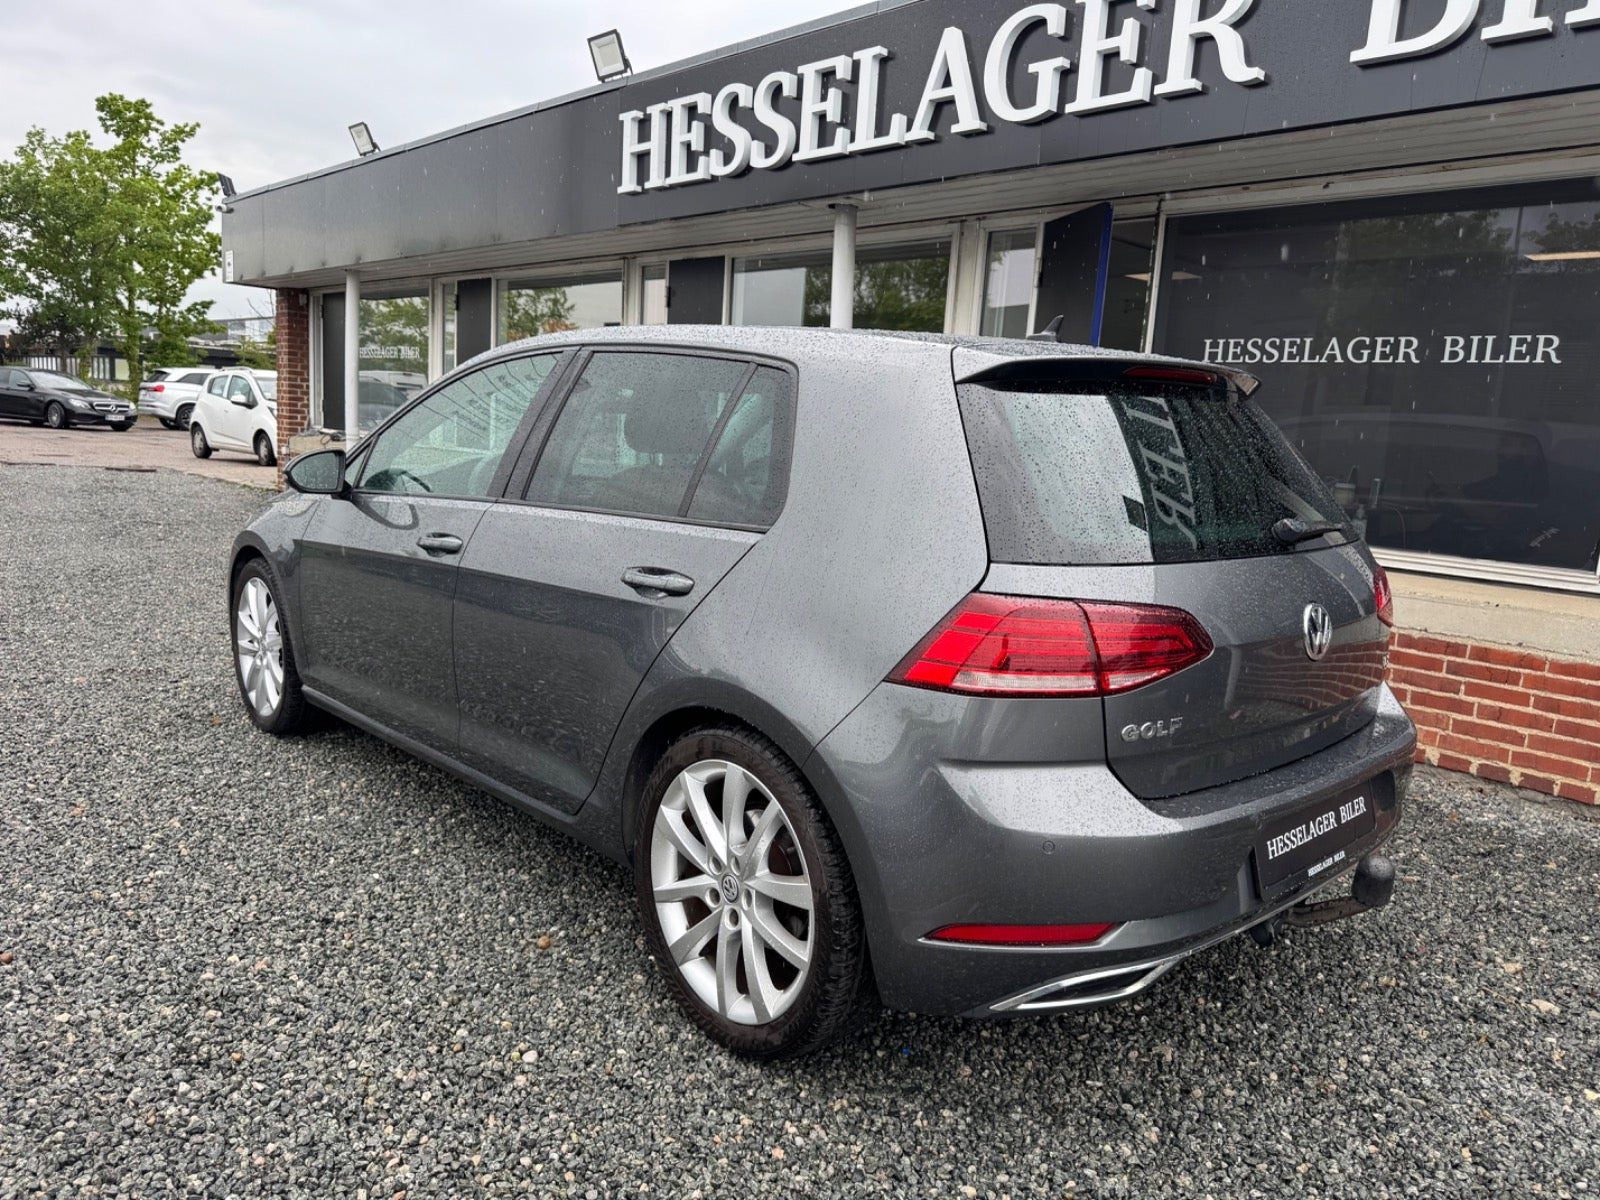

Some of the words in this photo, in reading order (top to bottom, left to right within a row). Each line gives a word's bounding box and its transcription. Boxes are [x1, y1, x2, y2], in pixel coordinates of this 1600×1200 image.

[618, 0, 1266, 193] HESSELAGER
[1204, 337, 1420, 363] HESSELAGER
[1441, 336, 1562, 363] BILER
[1121, 717, 1183, 743] GOLF
[1266, 812, 1337, 859] HESSELAGER
[1340, 796, 1366, 823] BILER
